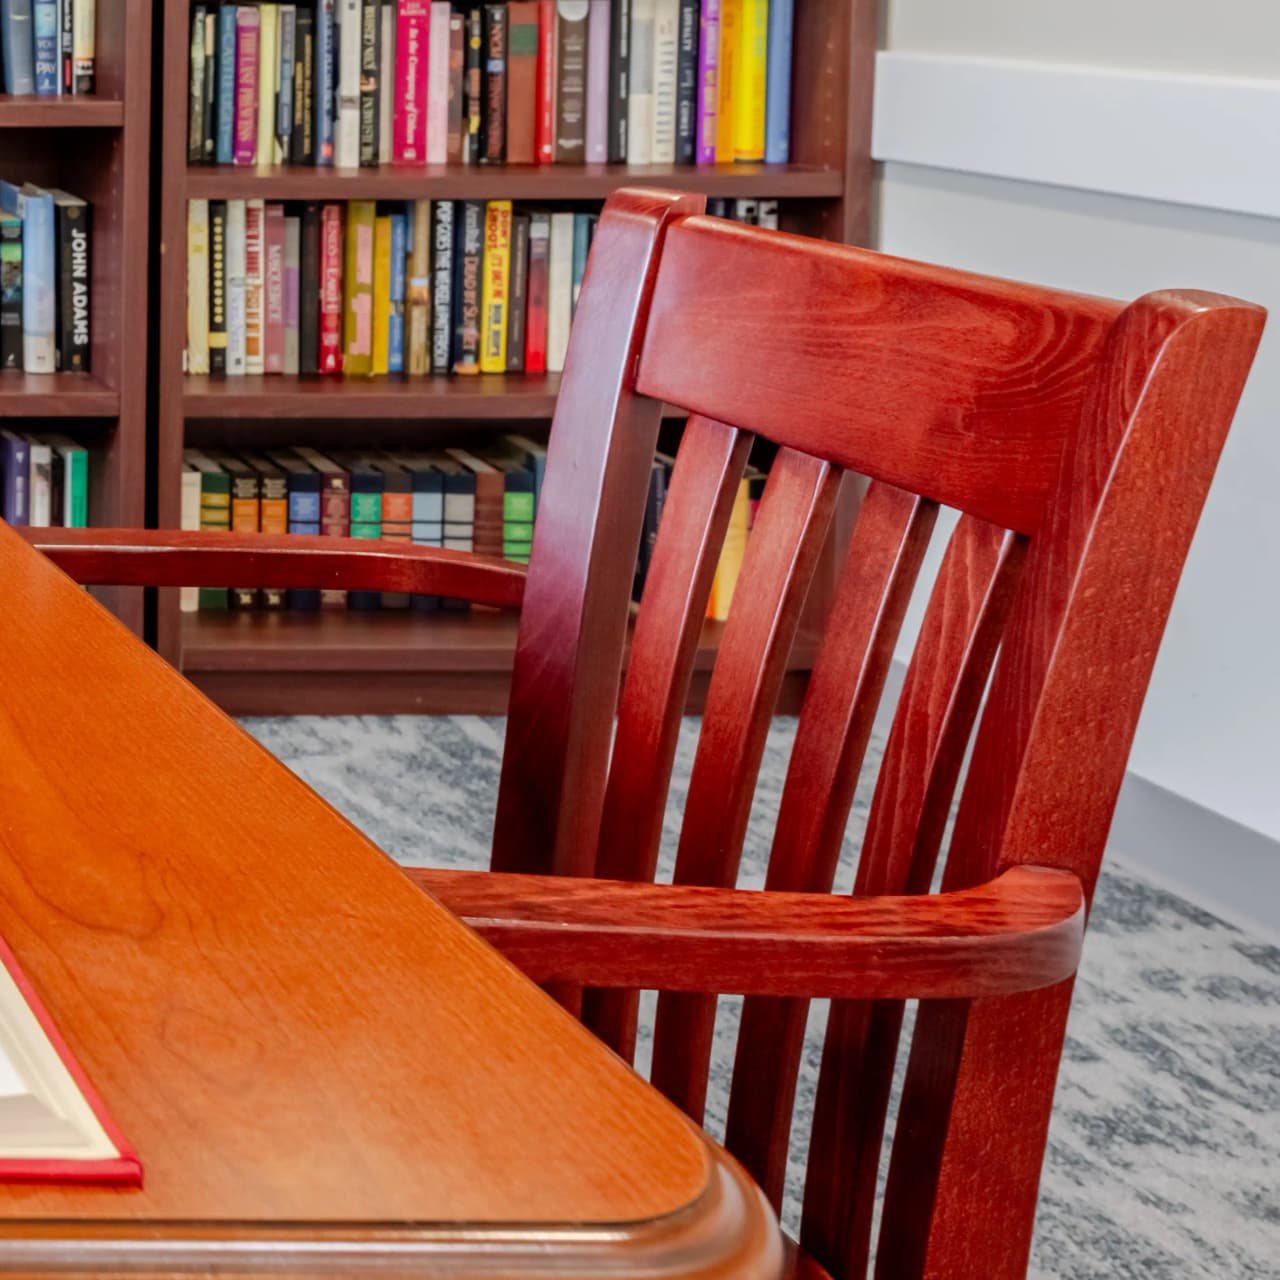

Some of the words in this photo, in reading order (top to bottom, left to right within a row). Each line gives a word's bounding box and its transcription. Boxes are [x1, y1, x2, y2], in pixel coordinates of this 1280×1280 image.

[684, 6, 693, 51] LOYALTY
[223, 32, 235, 84] CASTLE
[240, 56, 257, 85] LAST
[407, 58, 418, 103] Company
[407, 117, 418, 145] Others
[436, 201, 453, 223] POP
[500, 209, 510, 248] DON'T
[72, 228, 87, 276] JOHN
[436, 223, 453, 251] GOES
[436, 251, 453, 270] THE
[462, 256, 478, 290] DEAD
[436, 270, 453, 306] WEASEL
[72, 281, 87, 344] ADAMS
[492, 304, 503, 325] BOB
[436, 310, 453, 368] PATTERSON
[492, 330, 503, 358] HOPE
